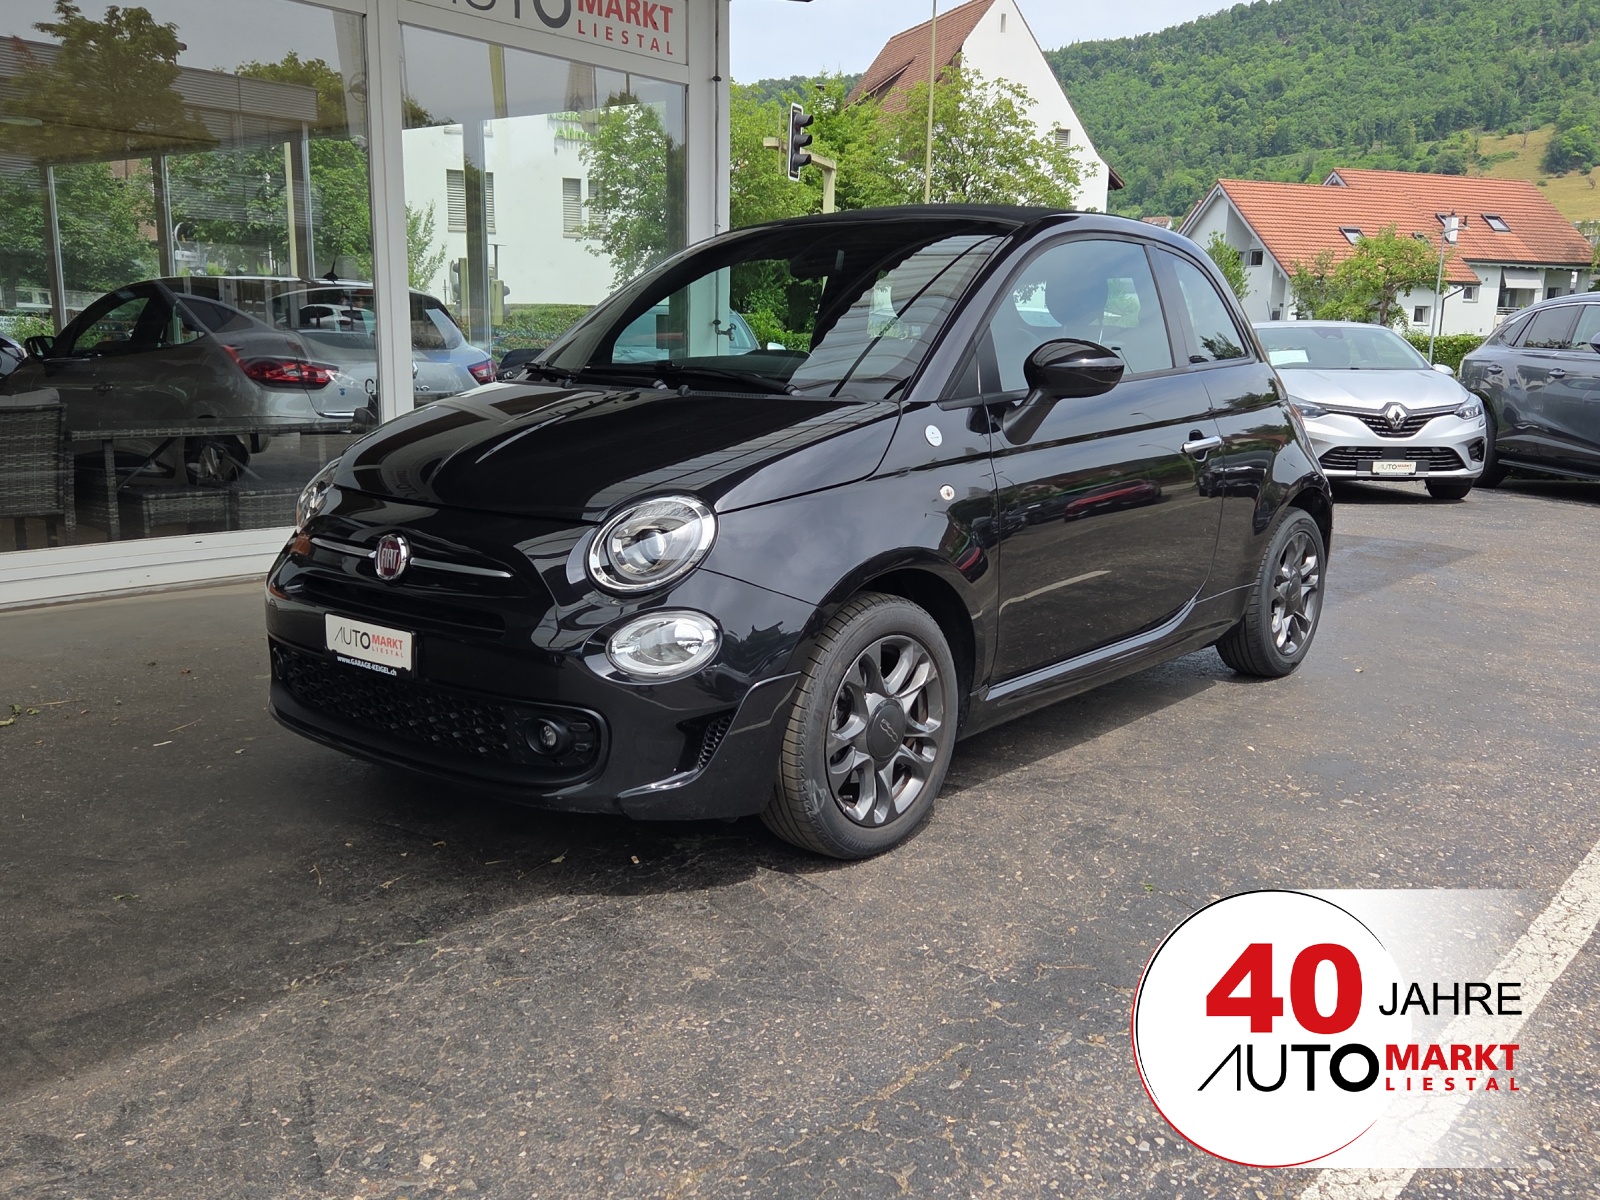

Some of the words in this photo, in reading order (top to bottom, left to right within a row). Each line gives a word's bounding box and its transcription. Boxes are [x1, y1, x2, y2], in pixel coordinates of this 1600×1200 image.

[577, 19, 674, 56] LIESTAL
[381, 548, 398, 569] FIAT
[334, 626, 371, 650] AUTO
[371, 634, 404, 651] MARKT
[371, 645, 404, 659] LIESTAL
